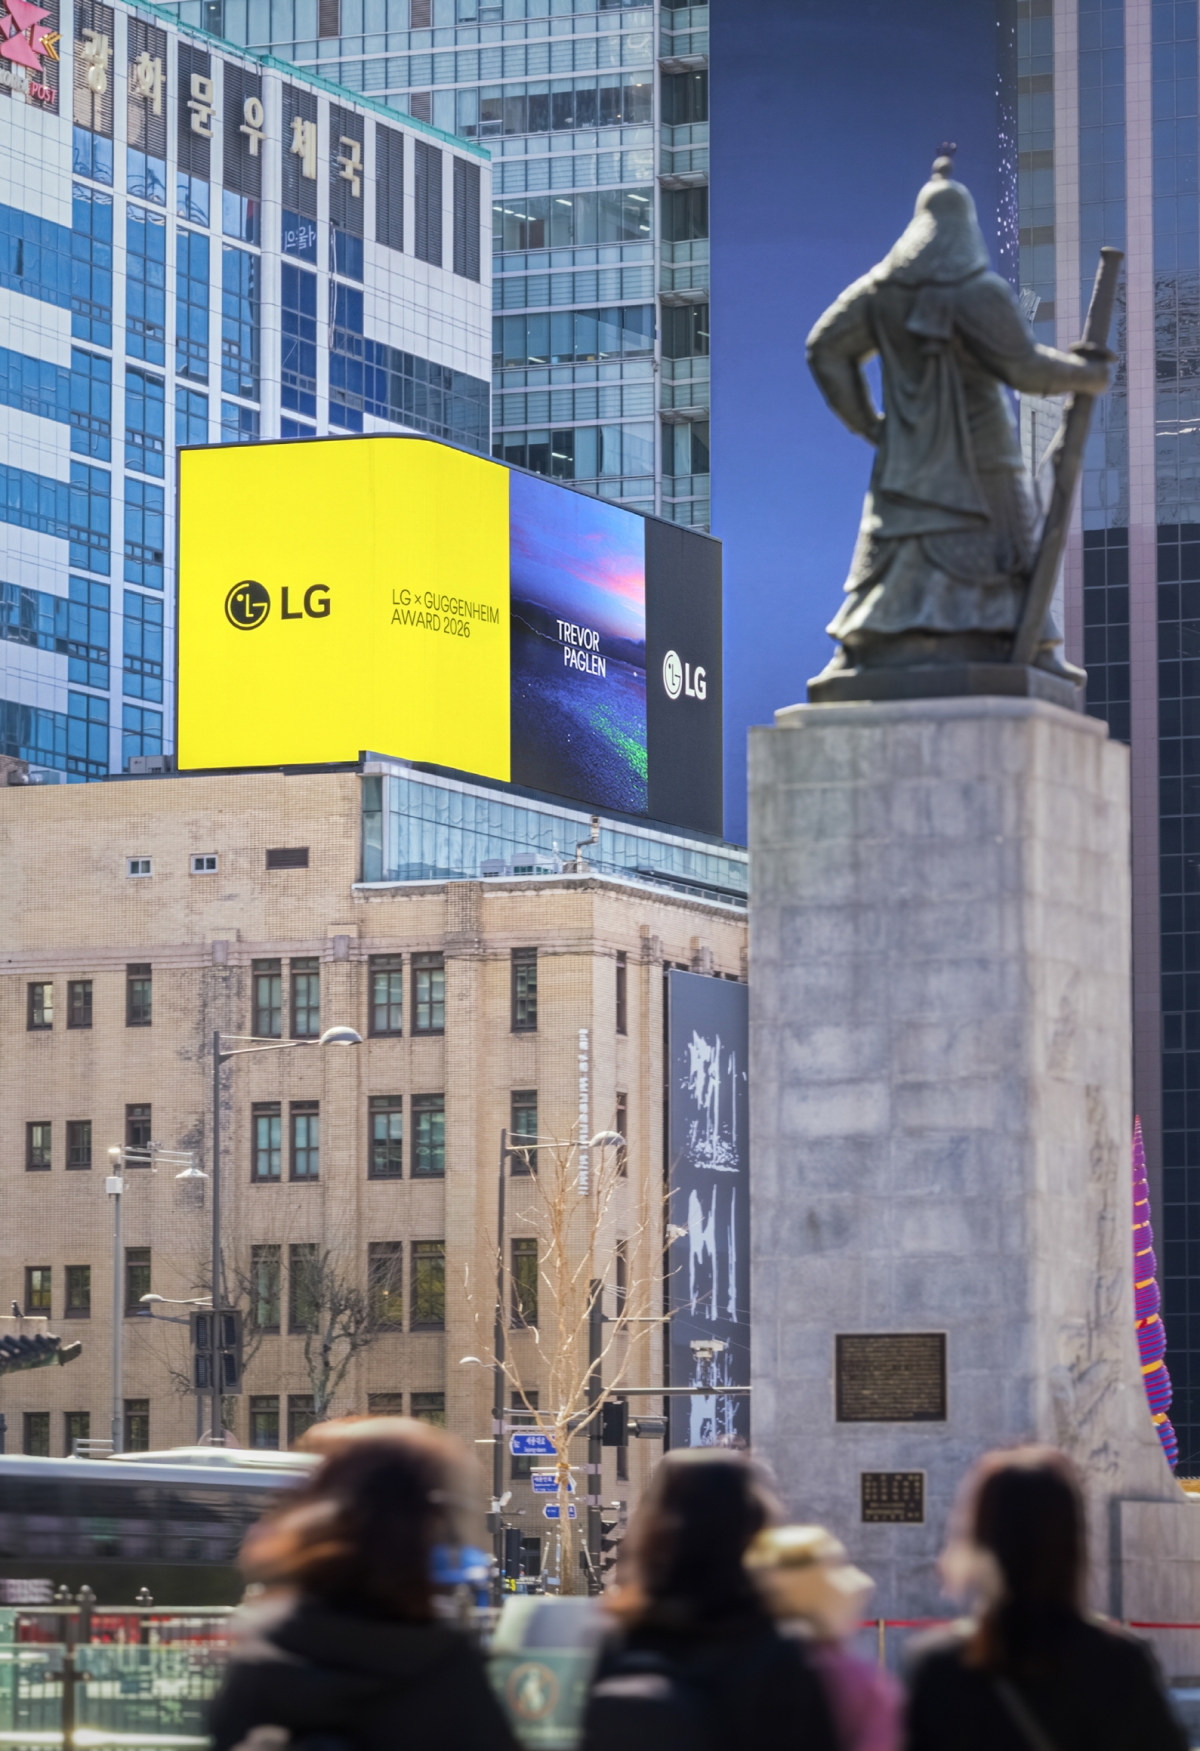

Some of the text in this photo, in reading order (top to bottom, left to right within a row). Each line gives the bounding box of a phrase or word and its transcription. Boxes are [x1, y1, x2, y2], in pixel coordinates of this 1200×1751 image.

[29, 81, 57, 104] POST
[281, 584, 331, 620] LG
[392, 589, 411, 606] LG
[424, 591, 499, 624] GUGGENHEIM
[391, 608, 471, 638] AWARD 2026
[556, 619, 600, 652] TREVOR
[564, 646, 606, 678] PAGLEN
[685, 663, 707, 700] LG
